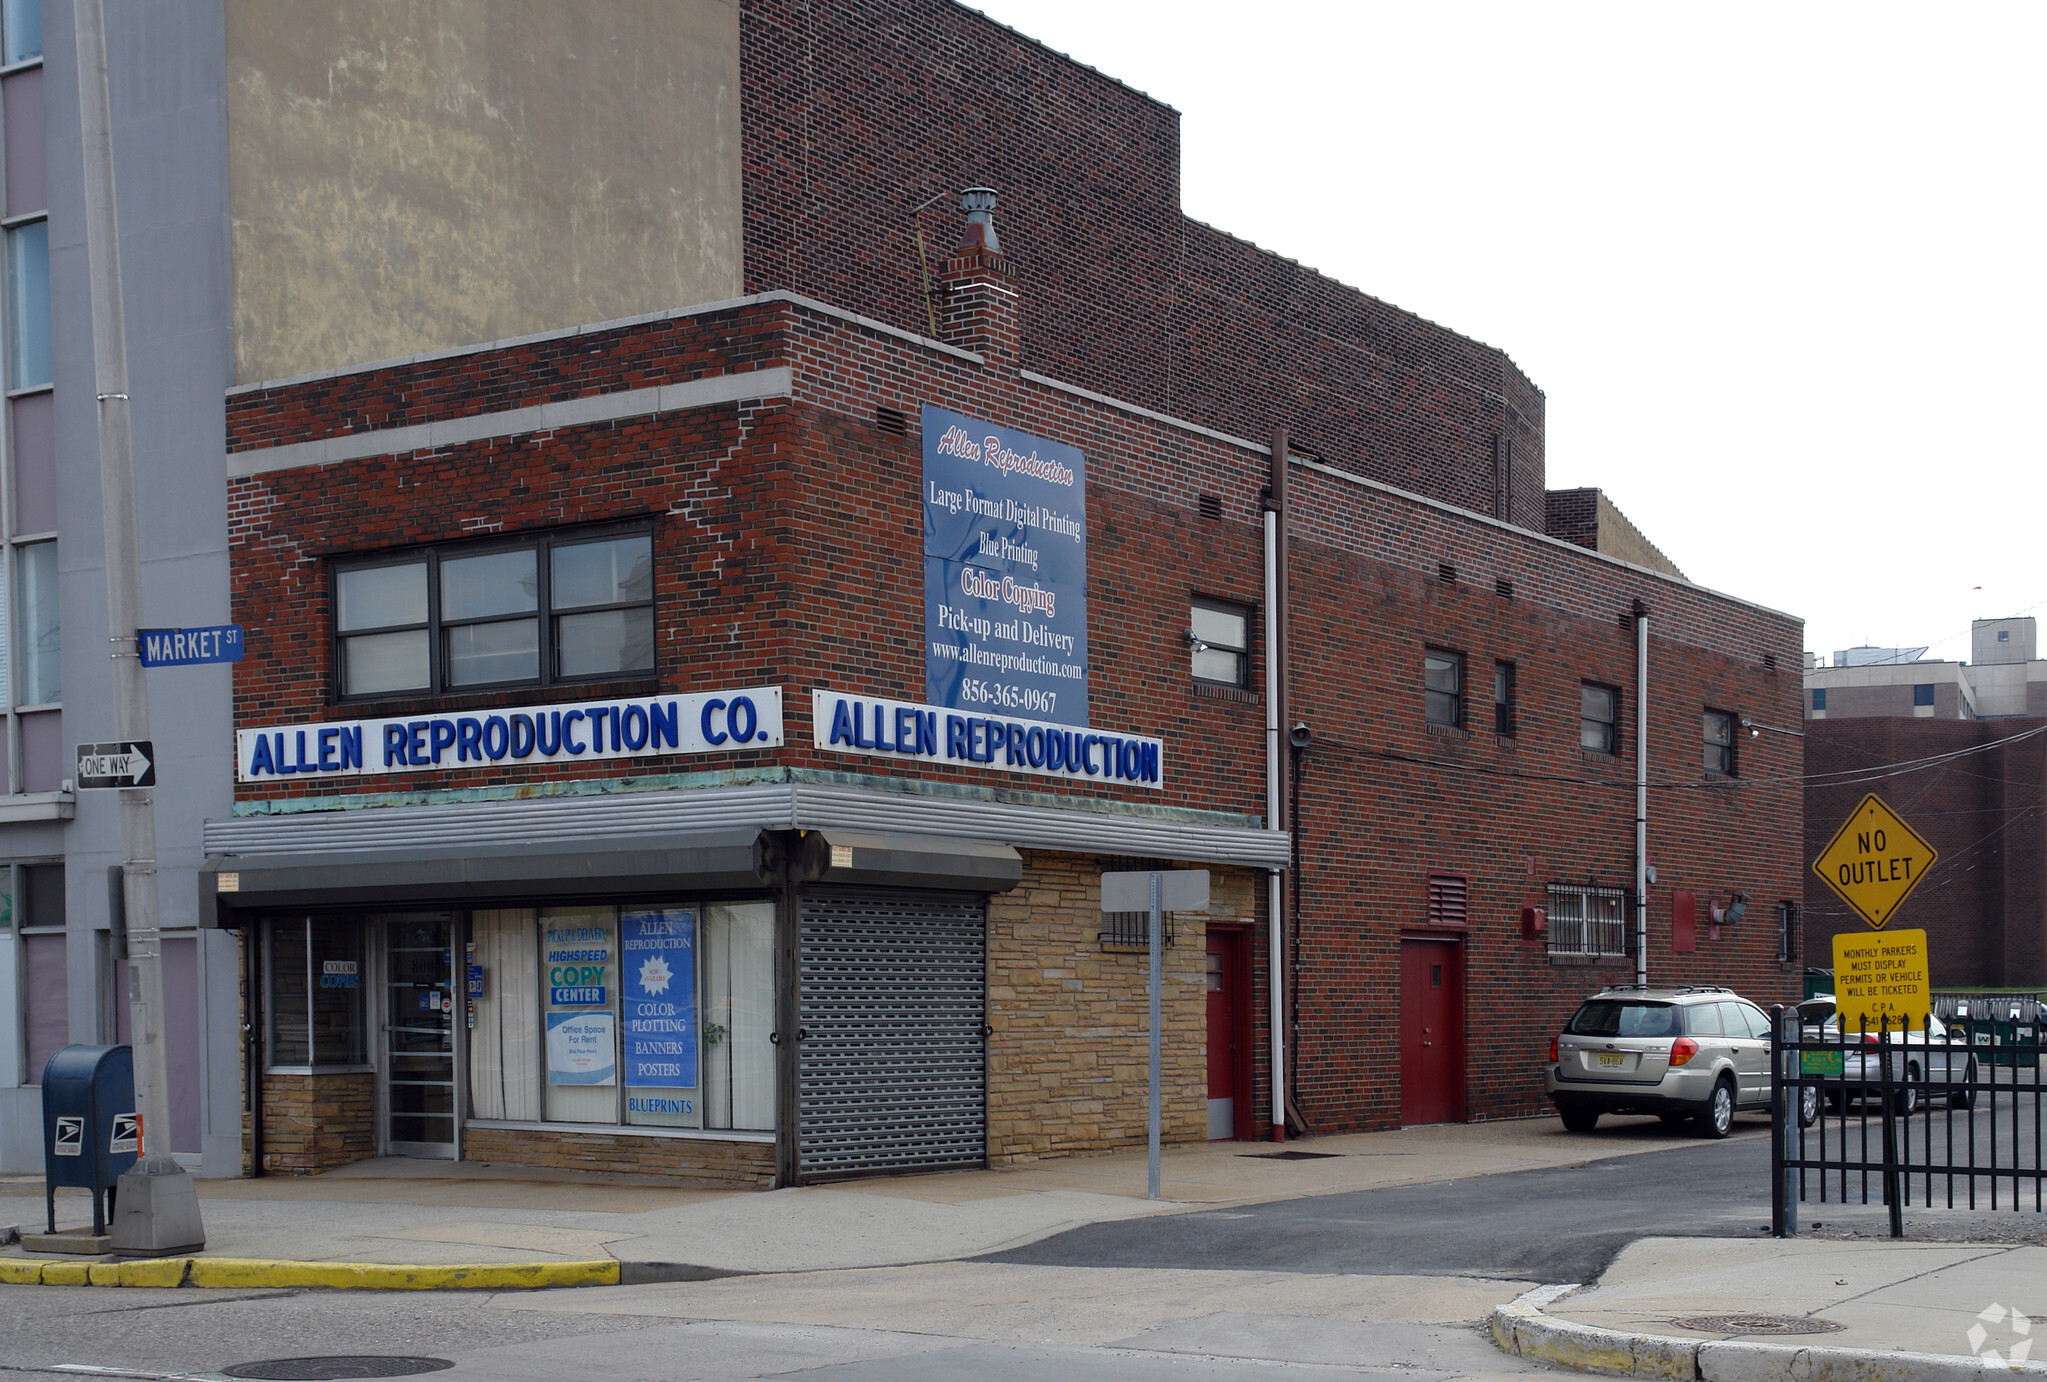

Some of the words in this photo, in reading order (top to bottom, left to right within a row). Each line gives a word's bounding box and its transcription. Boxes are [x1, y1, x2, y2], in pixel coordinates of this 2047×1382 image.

[937, 425, 981, 461] Allen
[984, 436, 1073, 486] Reproduction
[930, 481, 962, 514] Large
[965, 488, 1003, 520] Format
[1006, 498, 1040, 529] Digital
[1042, 507, 1080, 543] Printing
[979, 531, 999, 555] Blue
[1001, 536, 1038, 571] Printing
[961, 567, 1000, 601] Color
[1002, 576, 1055, 617] Copying
[938, 604, 990, 641] Pick-up
[995, 619, 1018, 641] and
[1022, 621, 1074, 656] Delivery
[147, 629, 223, 661] MARKET
[226, 629, 237, 644] ST
[933, 642, 1082, 679] www.allenreproduction.com
[962, 678, 1056, 713] 856-365-0967
[250, 726, 363, 775] ALLEN
[383, 701, 678, 767] REPRODUCTION
[700, 695, 768, 745] CO.
[830, 699, 937, 756] ALLEN
[947, 714, 1159, 783] REPRODUCTION
[85, 756, 105, 775] ONE
[109, 755, 131, 774] WAY
[1858, 829, 1886, 854] NO
[1839, 857, 1912, 886] OUTLET
[547, 928, 570, 944] PICKUP
[577, 927, 606, 942] DELIVERY
[639, 921, 673, 935] ALLEN
[625, 938, 691, 950] REPRODUCTION
[548, 949, 607, 962] HIGHSPEED
[1843, 948, 1878, 959] MONTHLY
[1881, 946, 1917, 957] PARKERS
[325, 963, 356, 973] COLOR
[1851, 961, 1873, 971] MUST
[1875, 959, 1906, 970] DISPLAY
[320, 974, 360, 988] COPIES
[550, 966, 606, 987] COPY
[1840, 974, 1873, 985] PERMITS
[1876, 973, 1887, 983] OR
[1890, 971, 1922, 982] VEHICLE
[556, 988, 600, 1002] CENTER
[1847, 986, 1865, 997] WILL
[1867, 986, 1877, 996] BE
[1882, 985, 1918, 996] TICKETED
[637, 1003, 675, 1016] COLOR
[562, 1025, 582, 1034] Office
[584, 1025, 606, 1035] Space
[632, 1019, 686, 1032] PLOTTING
[568, 1036, 579, 1044] For
[581, 1036, 597, 1044] Rent
[635, 1041, 682, 1055] BANNERS
[638, 1063, 680, 1076] POSTERS
[629, 1097, 692, 1114] BLUEPRINTS
